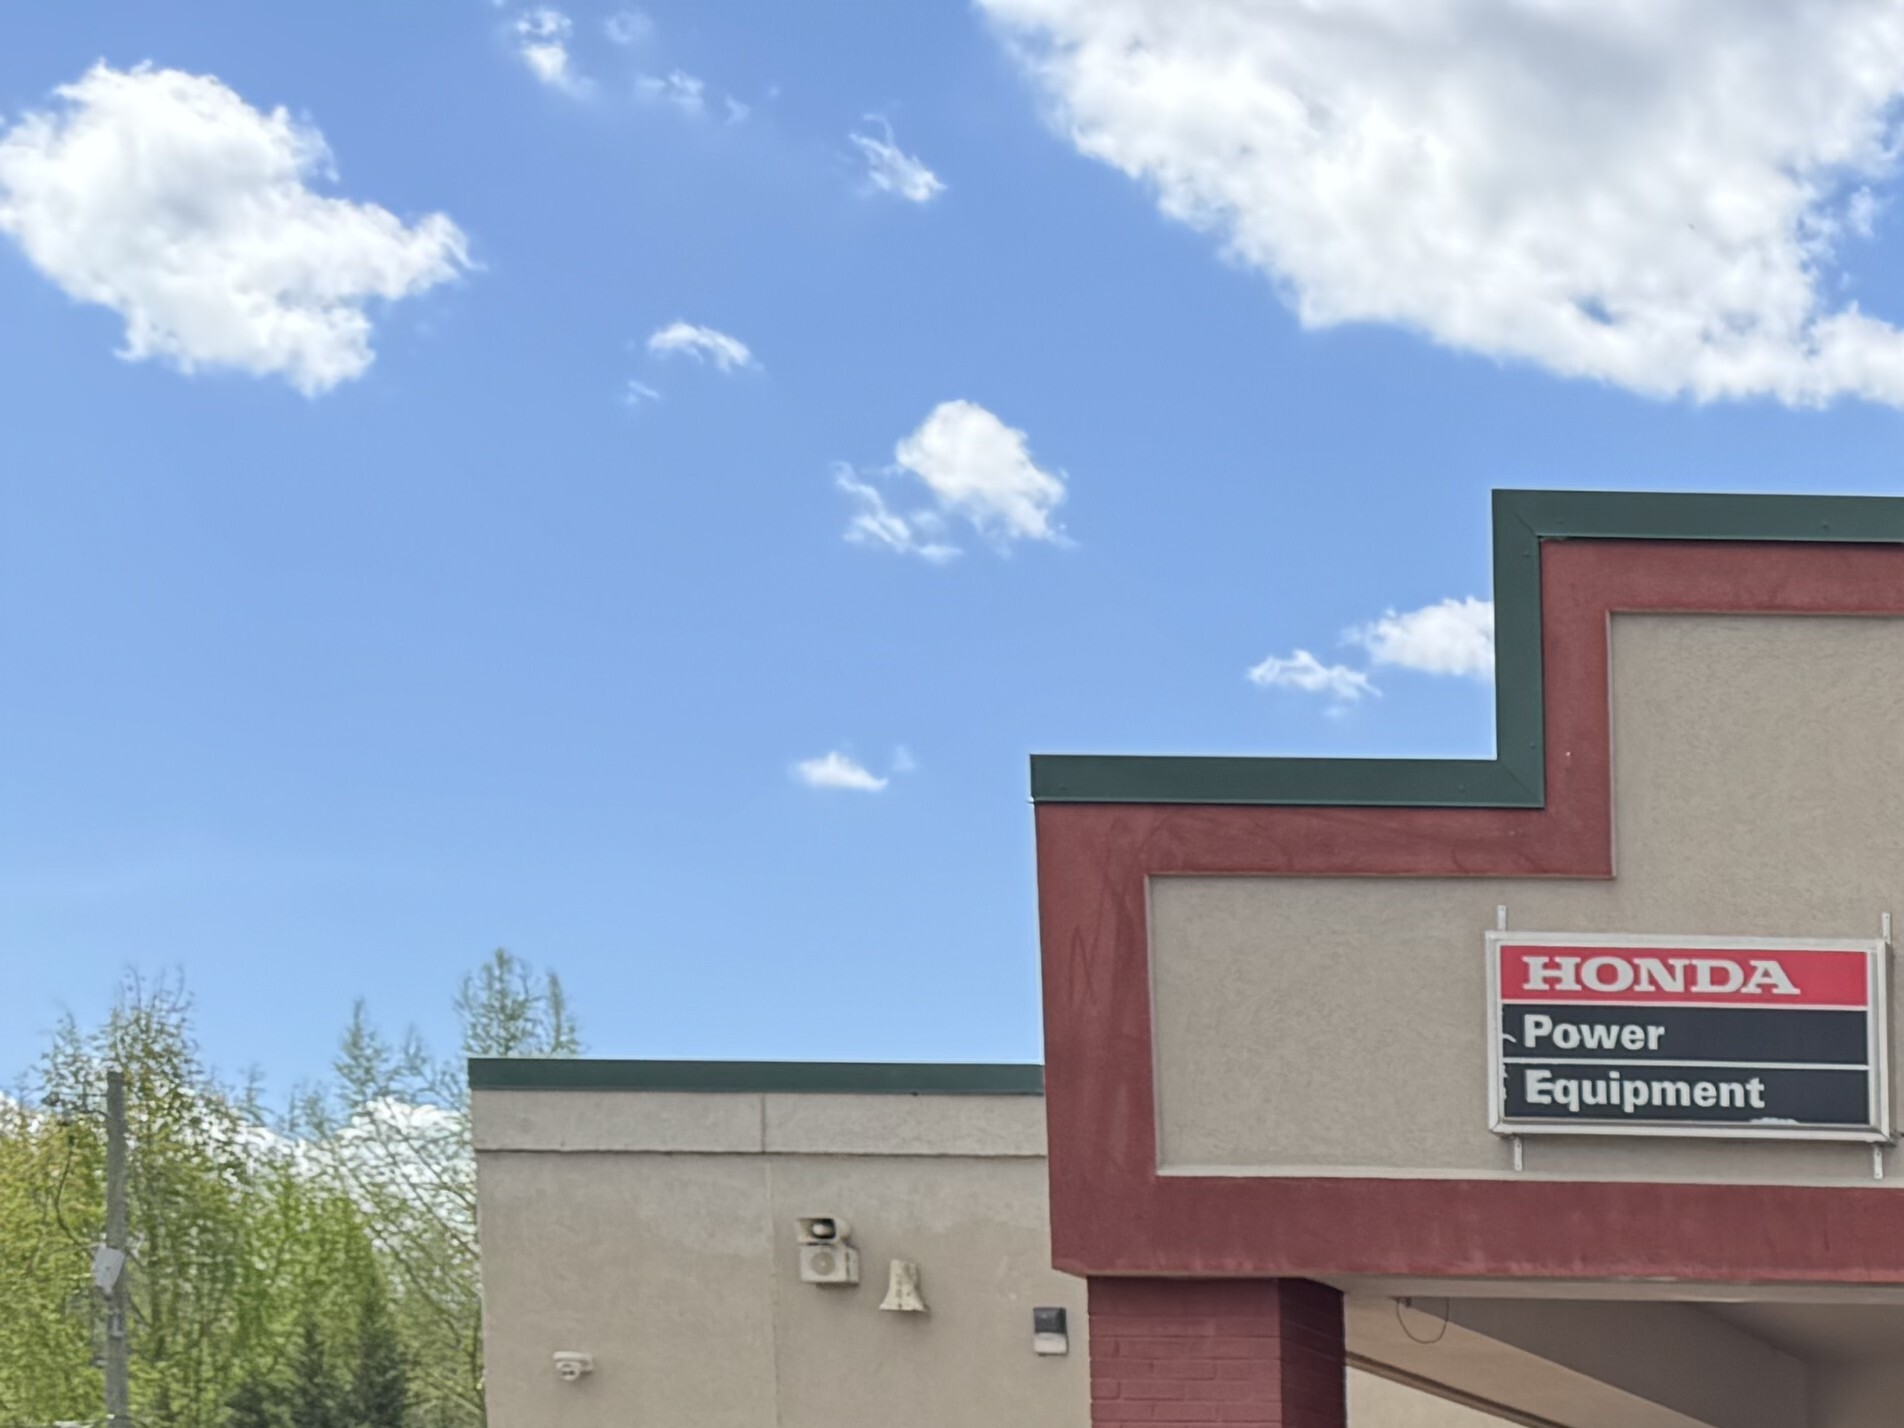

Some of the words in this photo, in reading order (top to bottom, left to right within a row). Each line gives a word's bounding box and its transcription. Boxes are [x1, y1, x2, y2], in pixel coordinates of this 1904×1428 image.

[1521, 956, 1800, 995] HONDA
[1524, 1014, 1665, 1050] Power
[1525, 1070, 1765, 1113] Equipment
